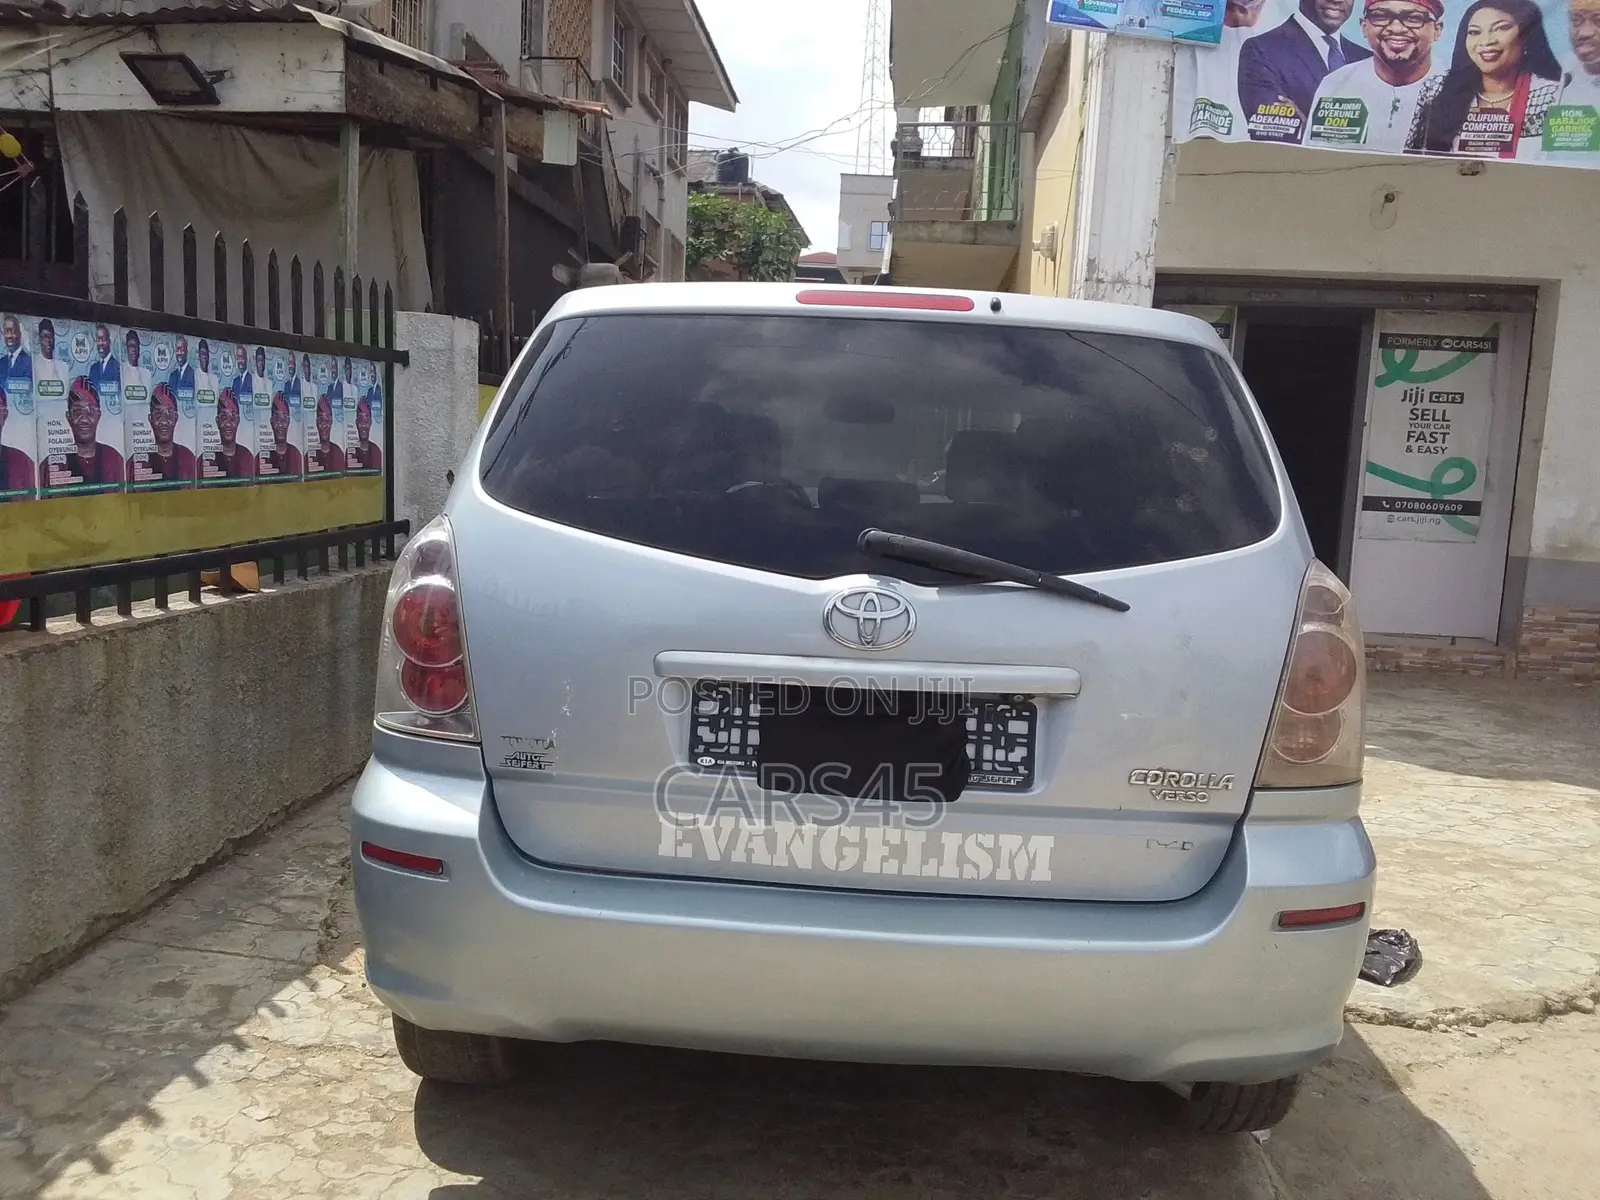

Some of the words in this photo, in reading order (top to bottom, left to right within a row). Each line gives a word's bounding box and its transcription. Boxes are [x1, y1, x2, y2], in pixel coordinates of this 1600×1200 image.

[1166, 6, 1197, 16] FEDERAL
[1257, 104, 1296, 117] BIMBO
[1317, 110, 1361, 119] OYEKUNLE
[1324, 117, 1349, 127] DON
[1467, 113, 1510, 123] OLUFUNKE
[1462, 122, 1515, 132] COMFORTER
[1387, 336, 1438, 347] FORMERLY
[1432, 393, 1462, 403] cars
[1409, 408, 1451, 422] SELL
[1409, 422, 1432, 430] YOUR
[47, 428, 71, 436] SUNDAY
[1406, 430, 1451, 445] FAST
[1405, 444, 1414, 454] &
[1417, 445, 1449, 455] EASY
[1395, 501, 1463, 512] 07080609609
[1128, 768, 1236, 791] COROLLA
[1150, 788, 1210, 804] VERSO
[658, 811, 1055, 883] EVANGELISM
